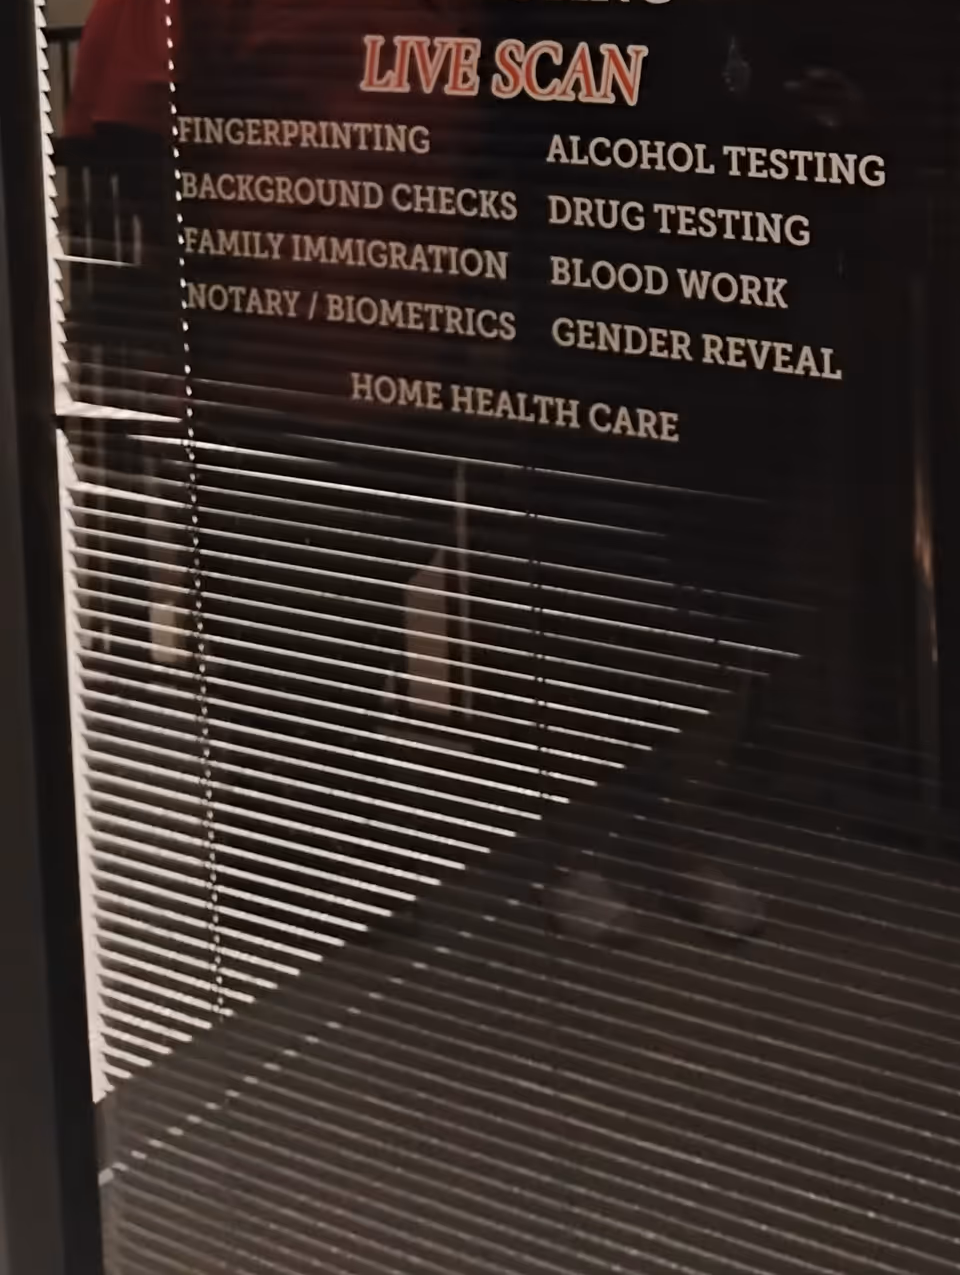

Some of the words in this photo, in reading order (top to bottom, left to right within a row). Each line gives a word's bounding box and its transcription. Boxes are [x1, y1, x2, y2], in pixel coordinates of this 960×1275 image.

[360, 35, 480, 95] LIVE
[491, 39, 648, 105] SCAN
[178, 116, 431, 155] FINGERPRINTING
[545, 134, 715, 176] ALCOHOL
[723, 145, 886, 188] TESTING
[181, 171, 384, 211] BACKGROUND
[391, 187, 518, 222] CHECKS
[547, 194, 646, 233] DRUG
[653, 203, 811, 247] TESTING
[184, 227, 284, 262] FAMILY
[292, 236, 509, 281] IMMIGRATION
[550, 255, 670, 296] BLOOD
[676, 267, 789, 309] WORK
[186, 281, 301, 320] NOTARY
[307, 290, 317, 322] /
[326, 294, 517, 341] BIOMETRICS
[551, 317, 693, 362] GENDER
[701, 332, 843, 380] REVEAL
[351, 371, 444, 411] HOME
[450, 384, 582, 429] HEALTH
[588, 401, 680, 443] CARE
